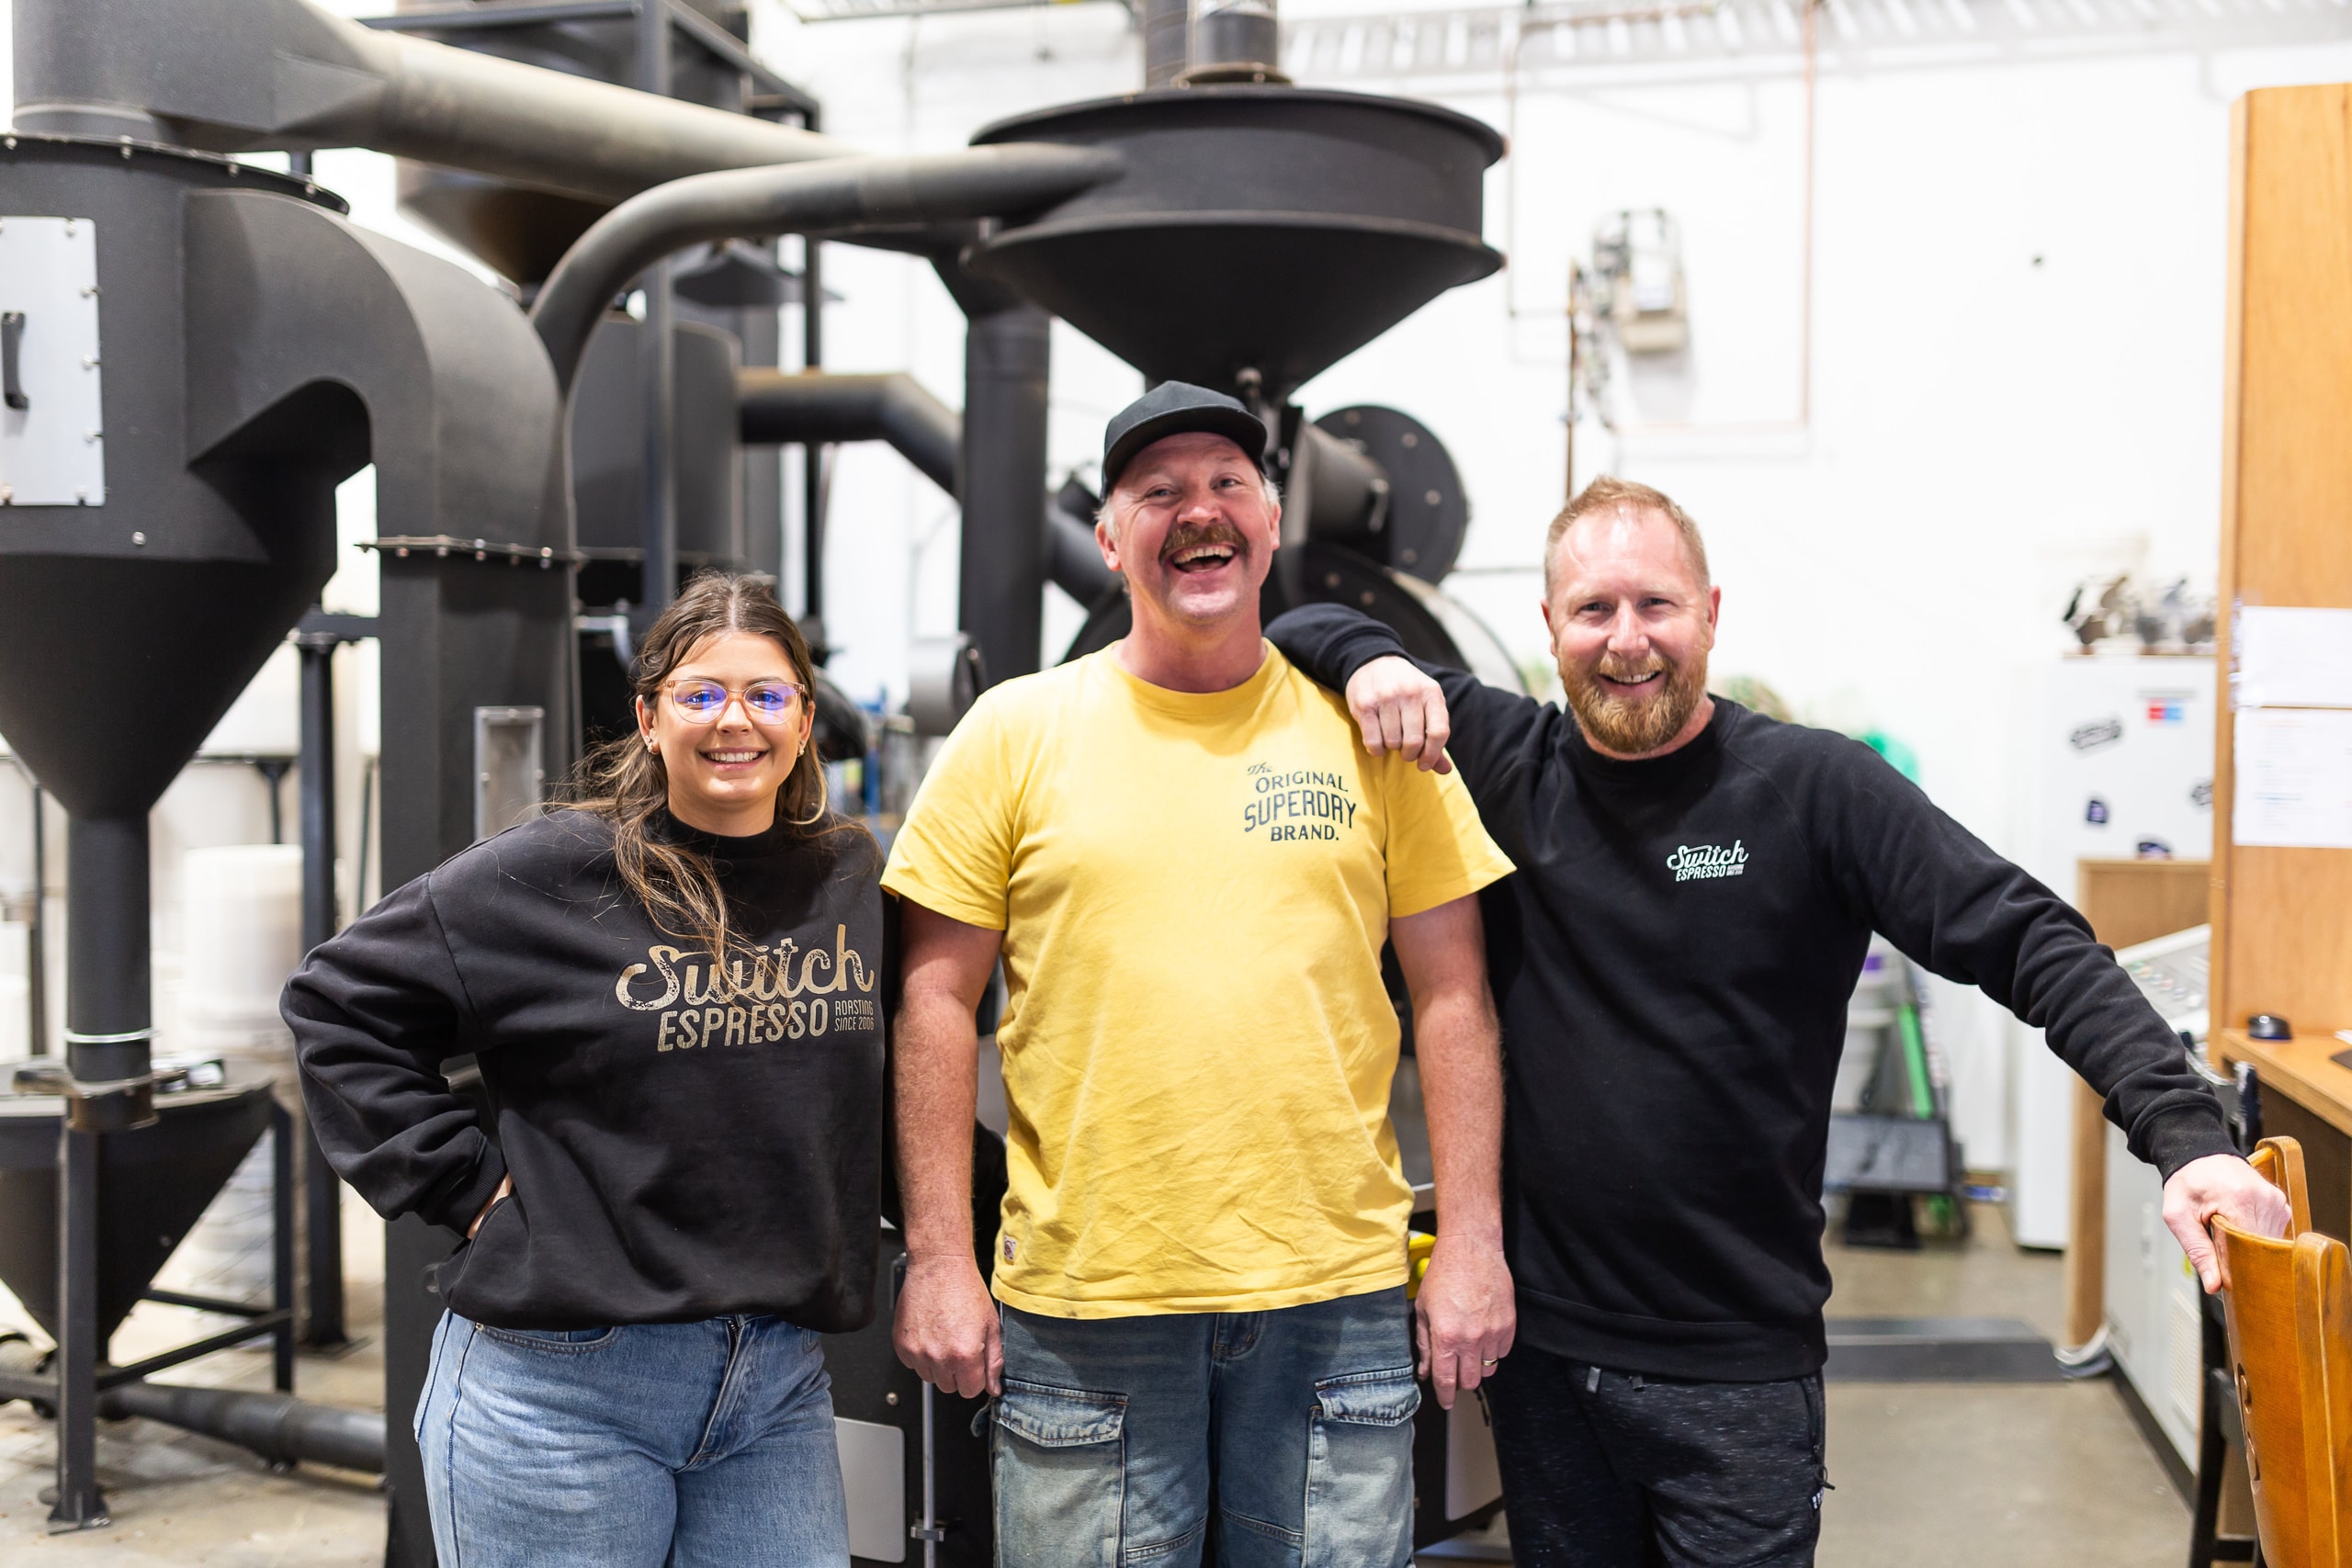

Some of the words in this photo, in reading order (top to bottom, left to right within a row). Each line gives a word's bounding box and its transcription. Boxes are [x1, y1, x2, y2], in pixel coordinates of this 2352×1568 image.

[1247, 761, 1272, 775] The
[1255, 772, 1349, 794] ORIGINAL
[1244, 790, 1357, 832] SUPERDRY
[1271, 824, 1340, 841] BRAND.
[1667, 840, 1749, 870] Switch
[1675, 864, 1726, 882] ESPRESSO
[615, 923, 875, 1010] Switch
[835, 999, 874, 1016] ROASTING
[657, 998, 828, 1052] ESPRESSO
[834, 1017, 856, 1032] SINCE
